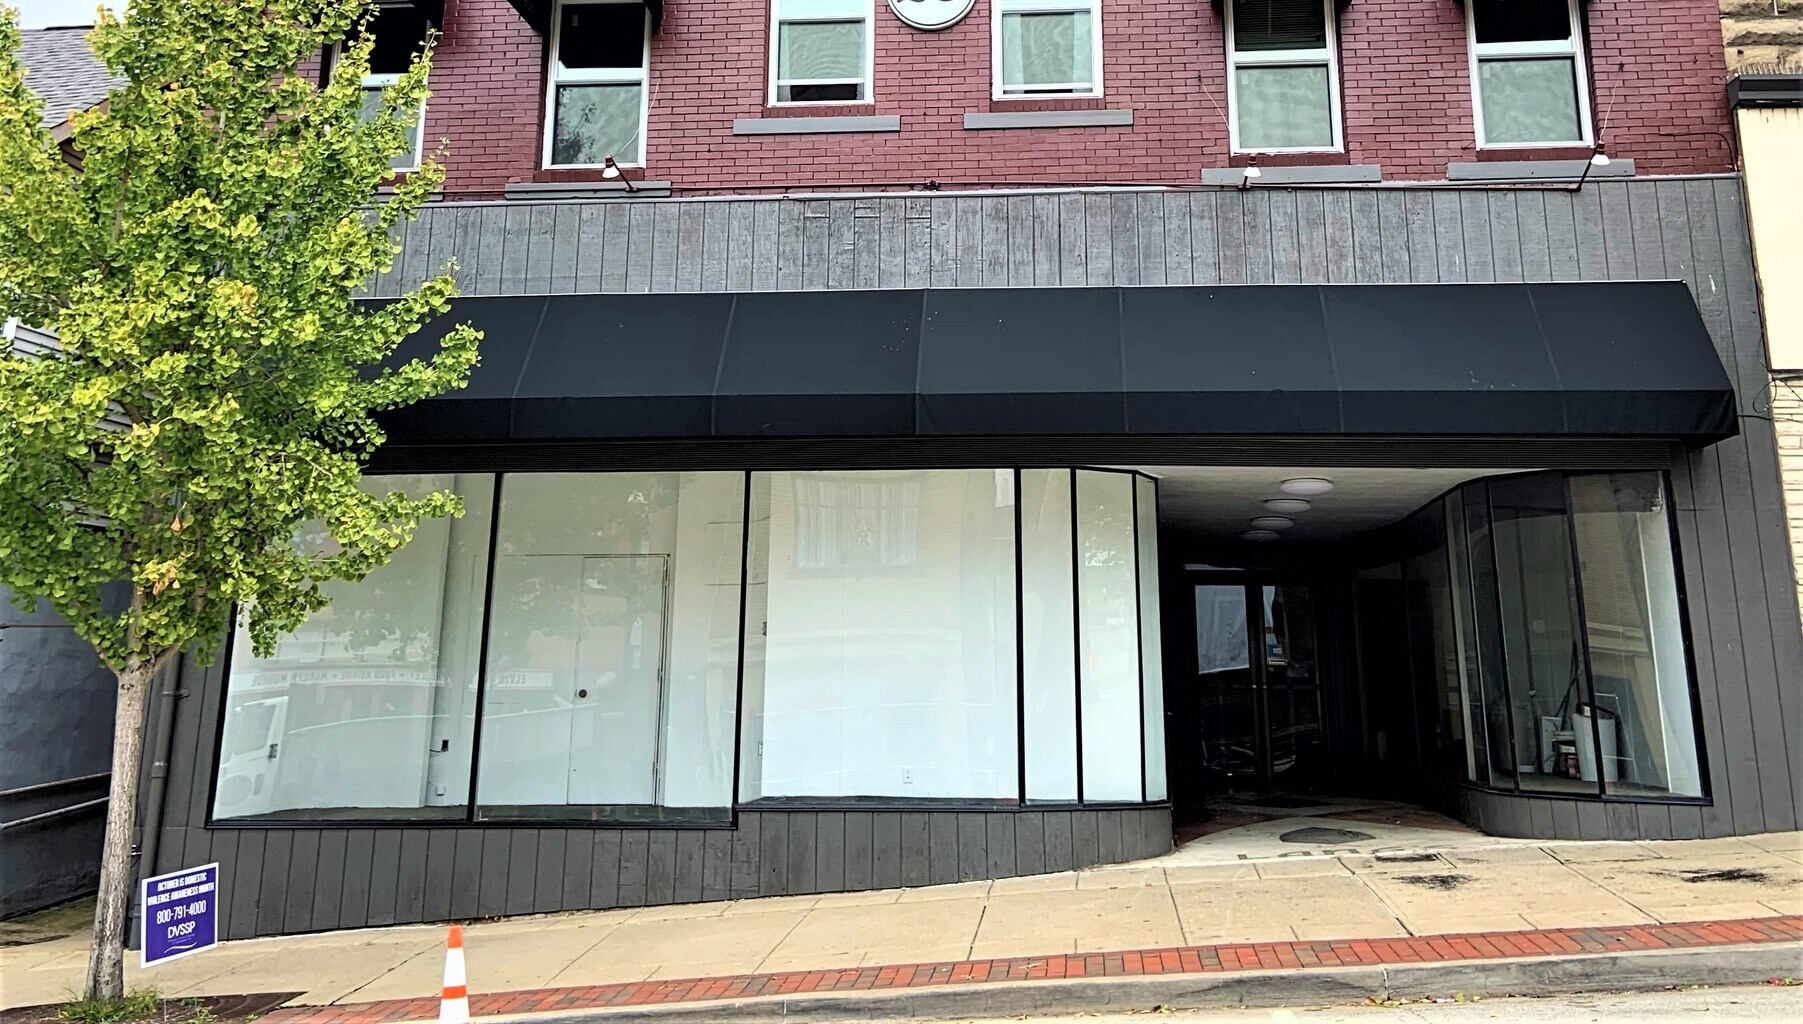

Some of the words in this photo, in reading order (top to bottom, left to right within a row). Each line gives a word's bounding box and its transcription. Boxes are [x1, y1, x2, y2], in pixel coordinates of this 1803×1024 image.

[158, 879, 179, 891] OCTOBER
[185, 872, 207, 885] DOMESTIC
[147, 892, 170, 906] VIOLENCE
[171, 886, 199, 900] AWARENESS
[157, 900, 206, 924] 800-791-4000
[168, 921, 195, 938] DVSSP
